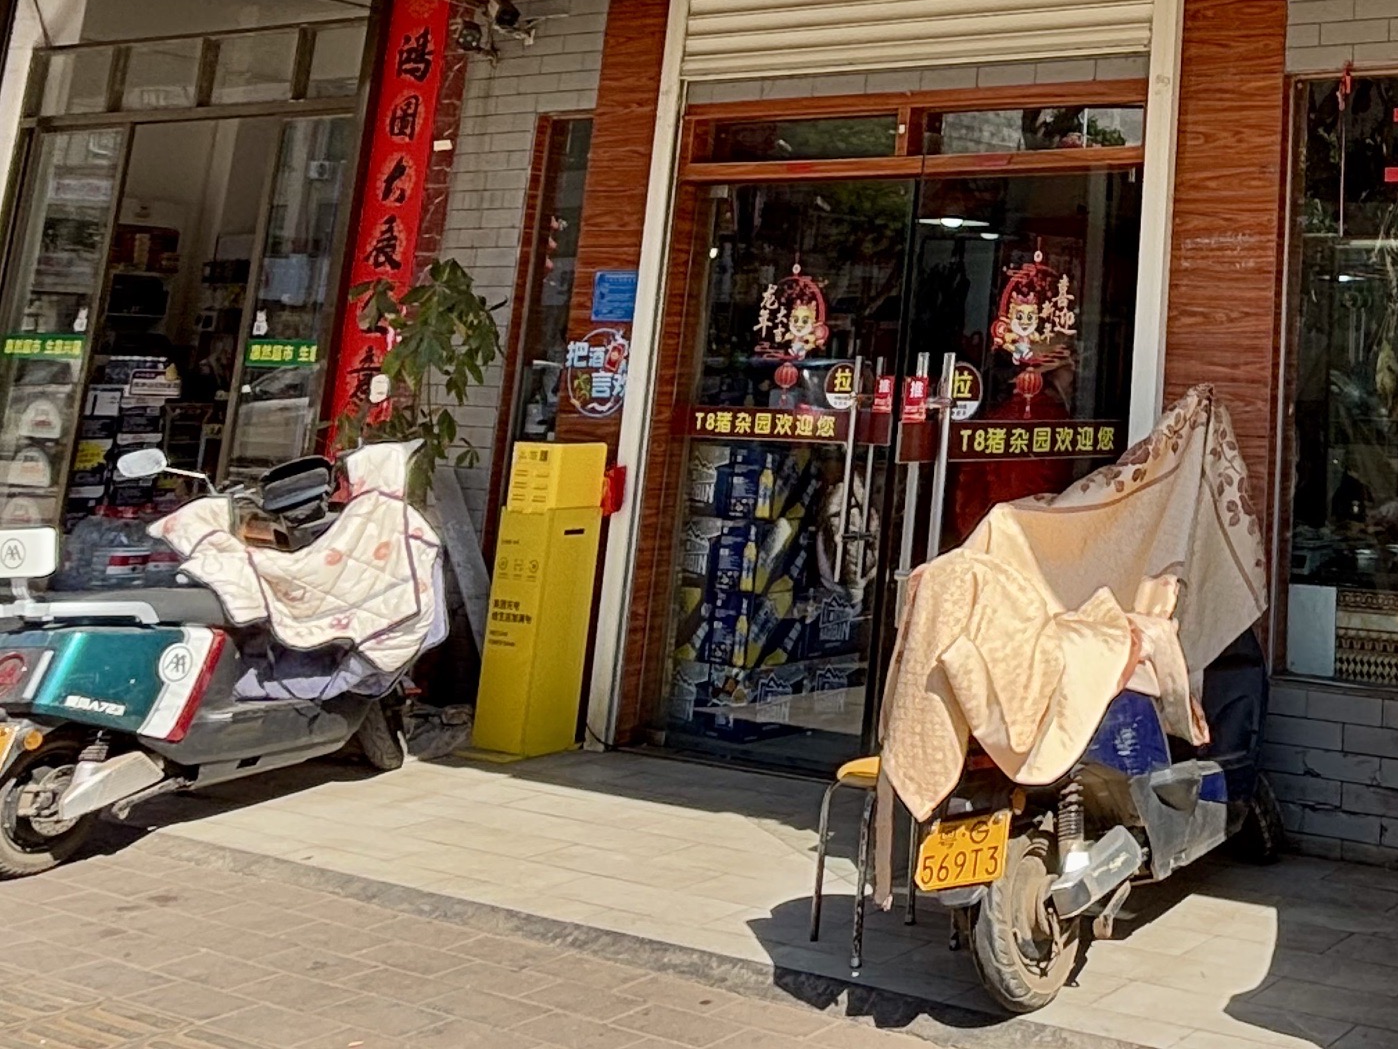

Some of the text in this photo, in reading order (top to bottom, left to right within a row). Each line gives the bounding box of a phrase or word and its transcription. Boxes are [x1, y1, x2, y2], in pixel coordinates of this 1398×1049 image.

[834, 368, 852, 392] 拉
[910, 380, 924, 399] 推
[694, 411, 836, 438] T8猪杂园欢迎您
[960, 426, 1115, 454] T8猪杂园欢迎您
[921, 845, 999, 885] 569T3
